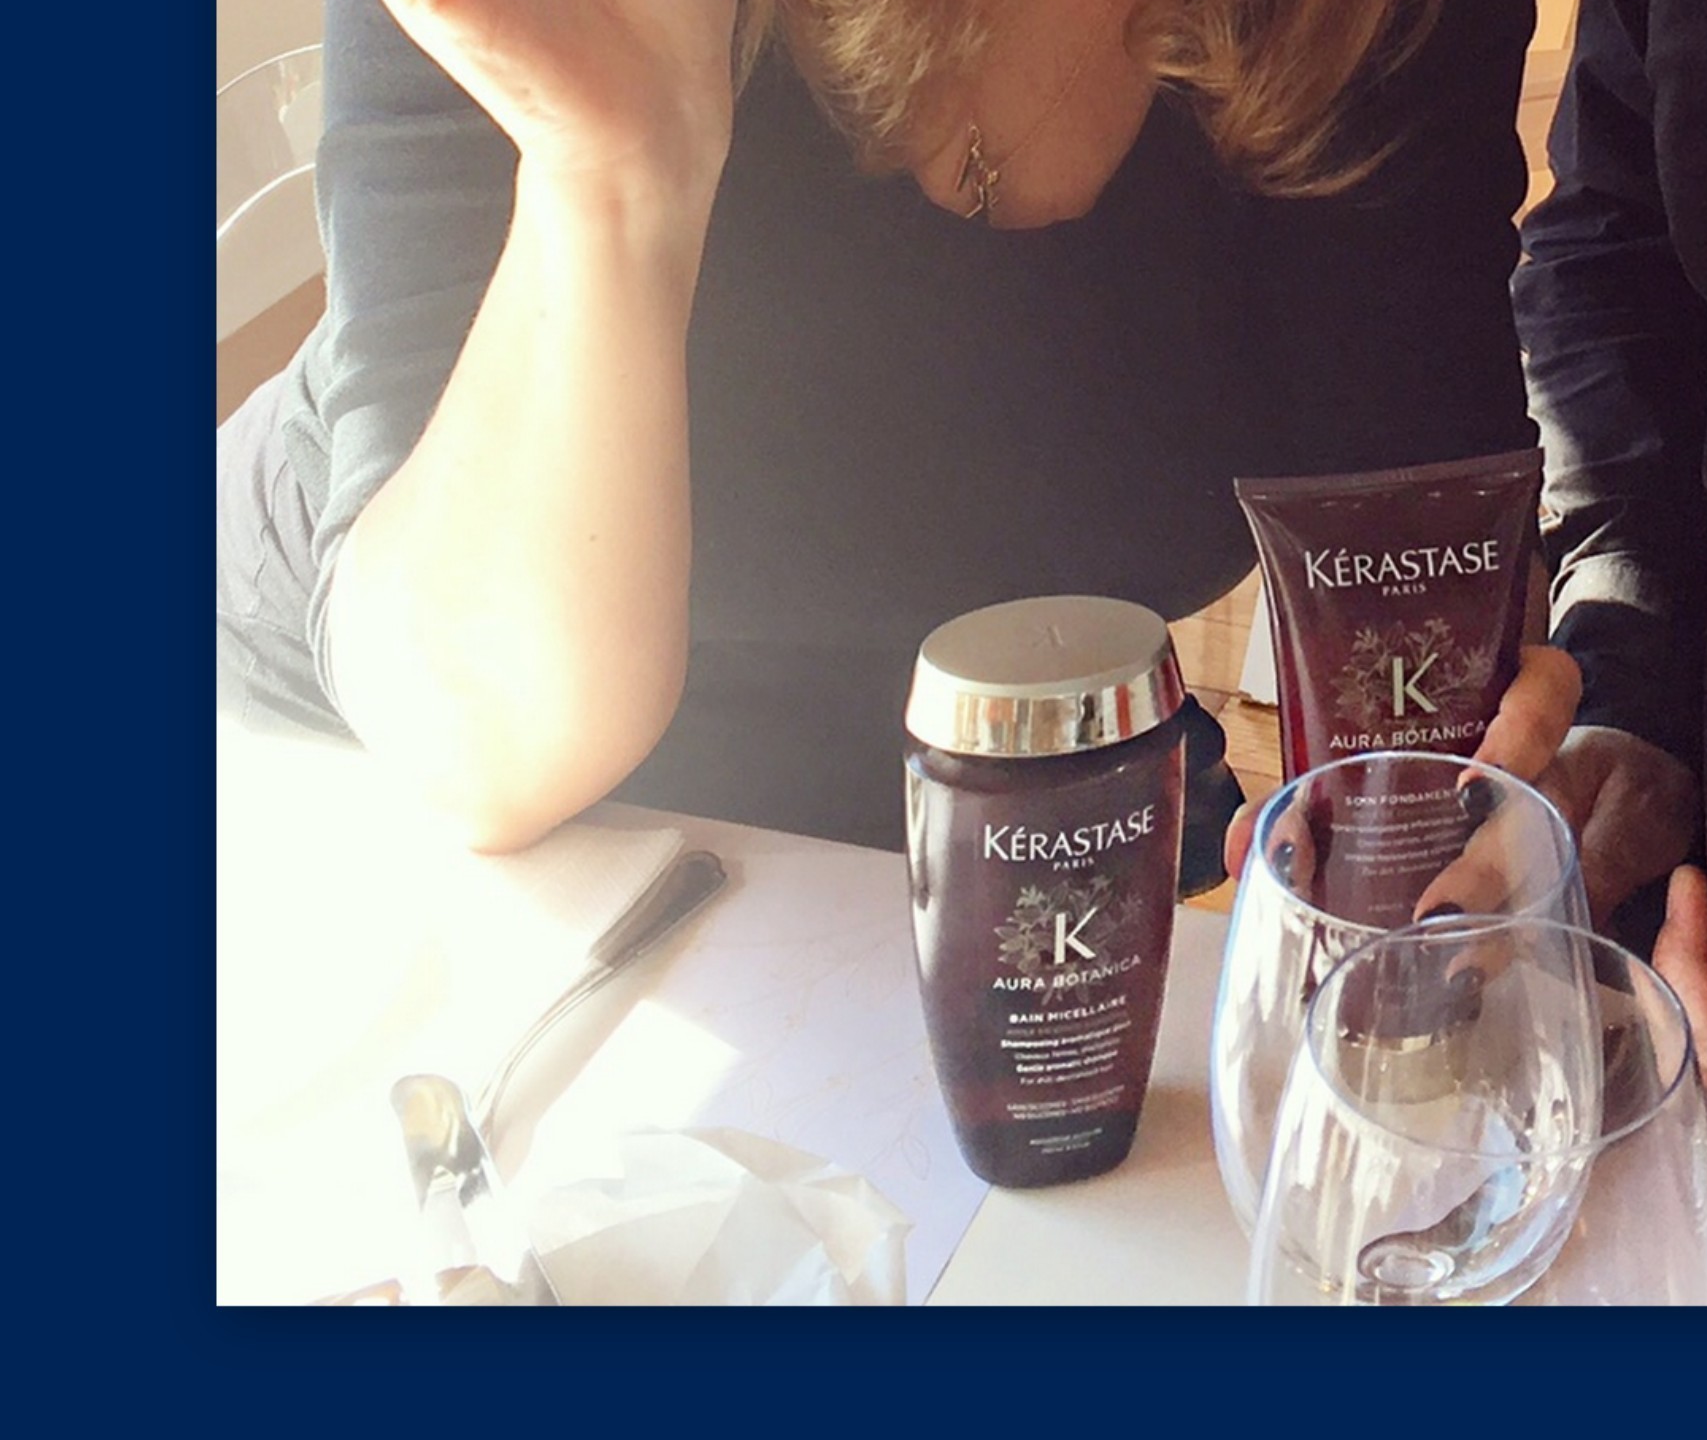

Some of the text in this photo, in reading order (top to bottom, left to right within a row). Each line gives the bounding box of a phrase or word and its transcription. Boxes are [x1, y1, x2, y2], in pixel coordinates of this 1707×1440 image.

[1305, 540, 1500, 589] KÉRASTASE
[1382, 583, 1427, 597] PARIS
[1392, 652, 1439, 717] K
[1329, 719, 1487, 750] AURA BOTANICA
[984, 805, 1155, 861] KÉRASTASE
[1053, 858, 1095, 871] PARIS
[1054, 907, 1099, 964] K
[993, 954, 1142, 991] AURA BOTANICA
